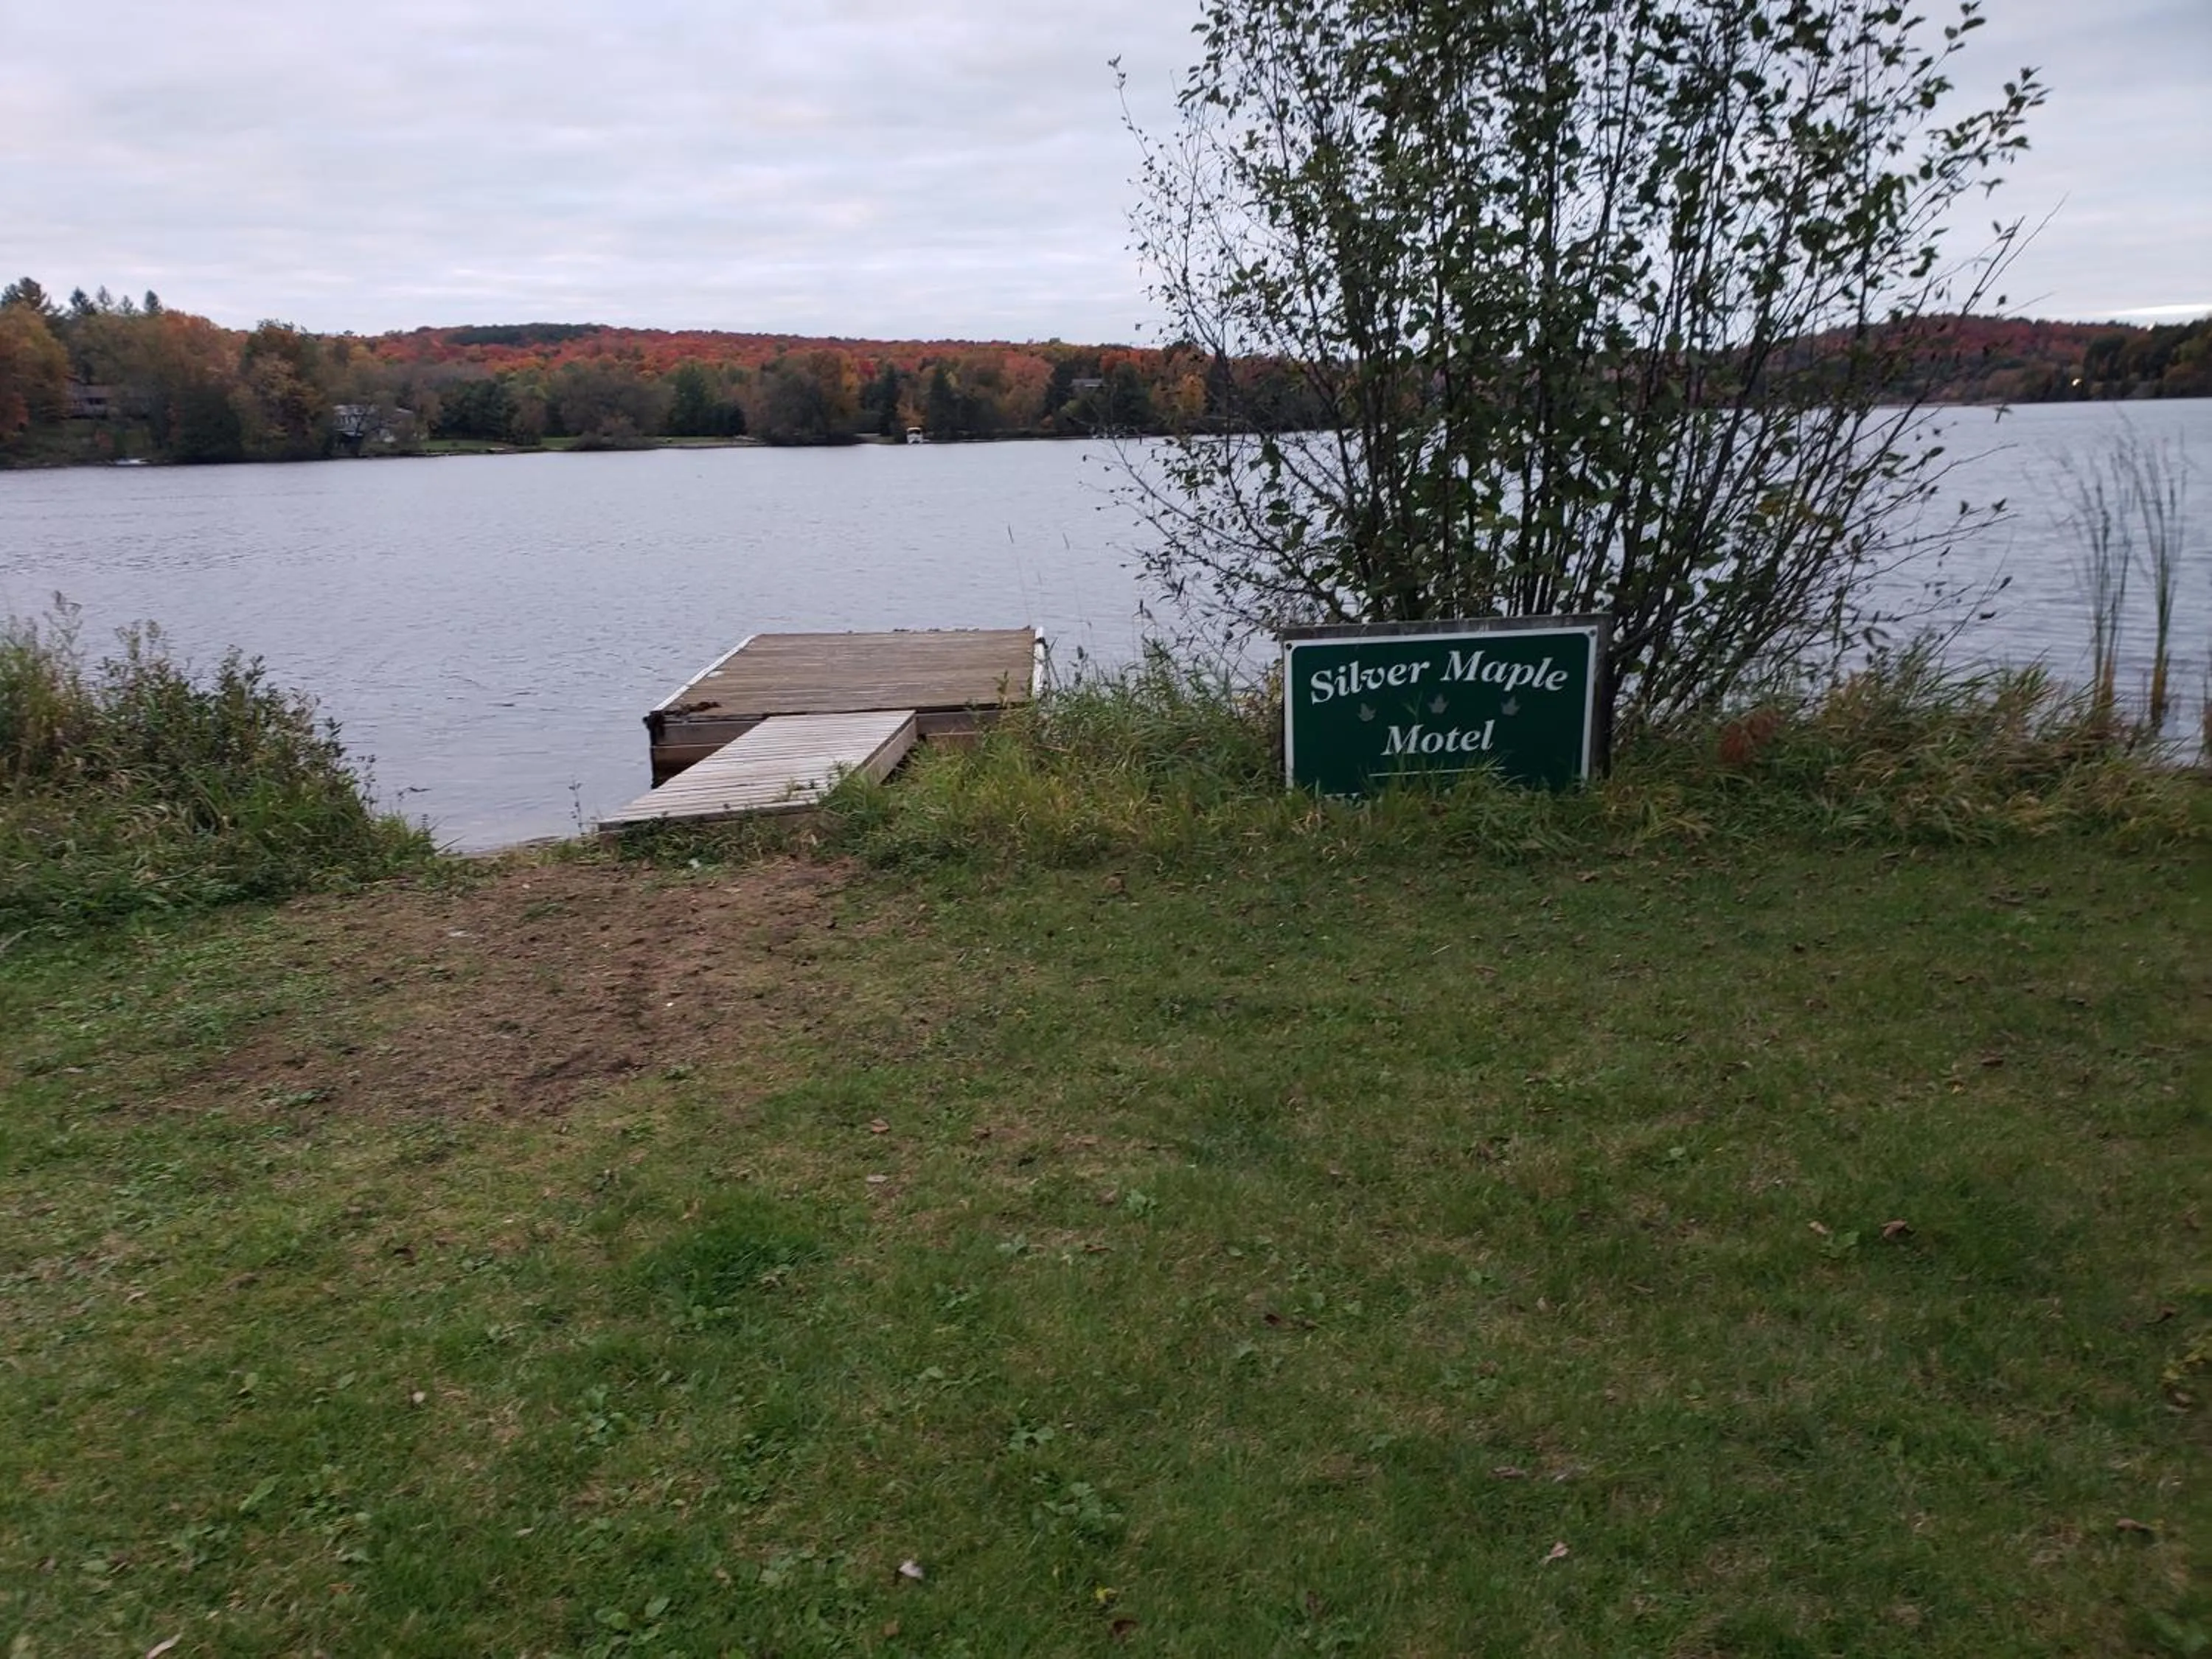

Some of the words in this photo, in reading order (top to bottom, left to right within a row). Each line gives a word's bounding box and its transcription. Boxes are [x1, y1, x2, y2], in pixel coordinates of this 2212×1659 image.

[1310, 660, 1431, 705] Silver
[1439, 650, 1569, 692] Maple
[1380, 720, 1496, 756] Motel
